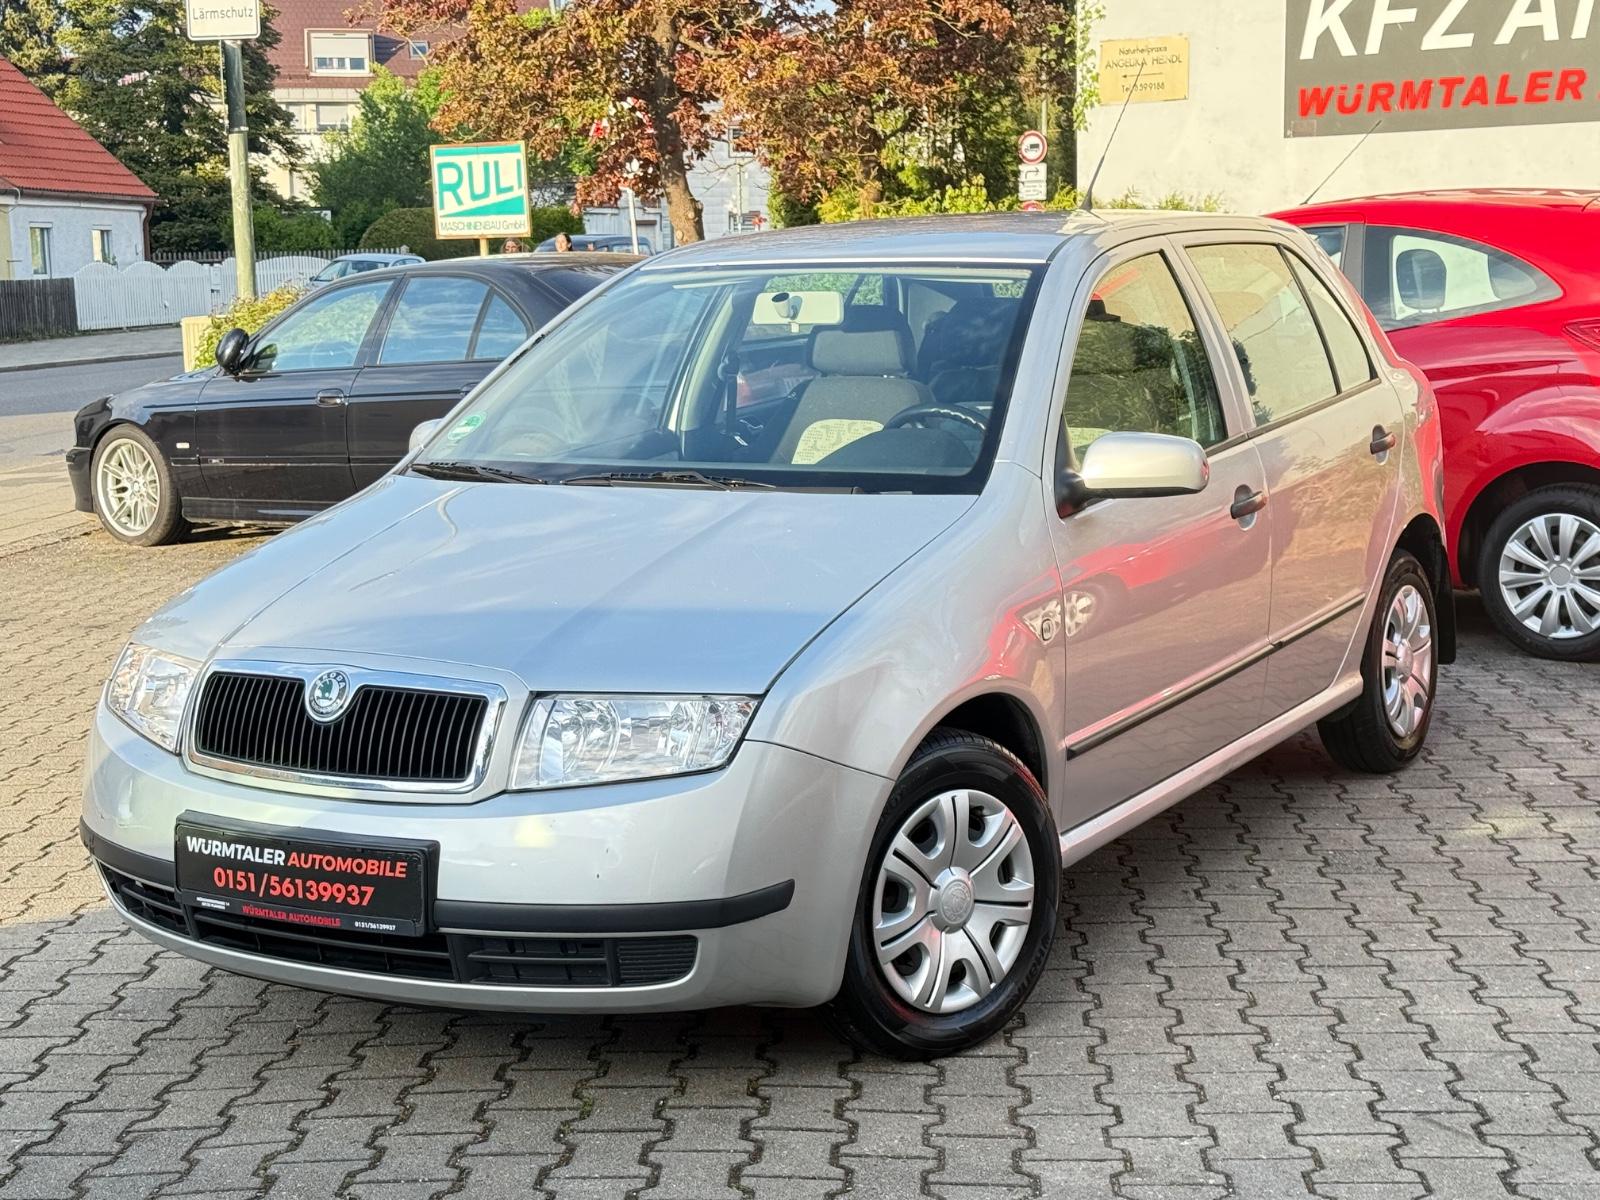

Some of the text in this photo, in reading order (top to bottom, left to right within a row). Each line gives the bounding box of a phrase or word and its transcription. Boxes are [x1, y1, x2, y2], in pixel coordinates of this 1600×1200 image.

[192, 6, 254, 20] Lärmschutz
[1299, 0, 1476, 60] KFZ
[1299, 69, 1587, 117] WÜRMTALER
[436, 159, 523, 210] RULI
[502, 220, 526, 231] GmbH
[287, 851, 408, 879] AUTOMOBILE
[213, 866, 375, 907] 0151/56139937
